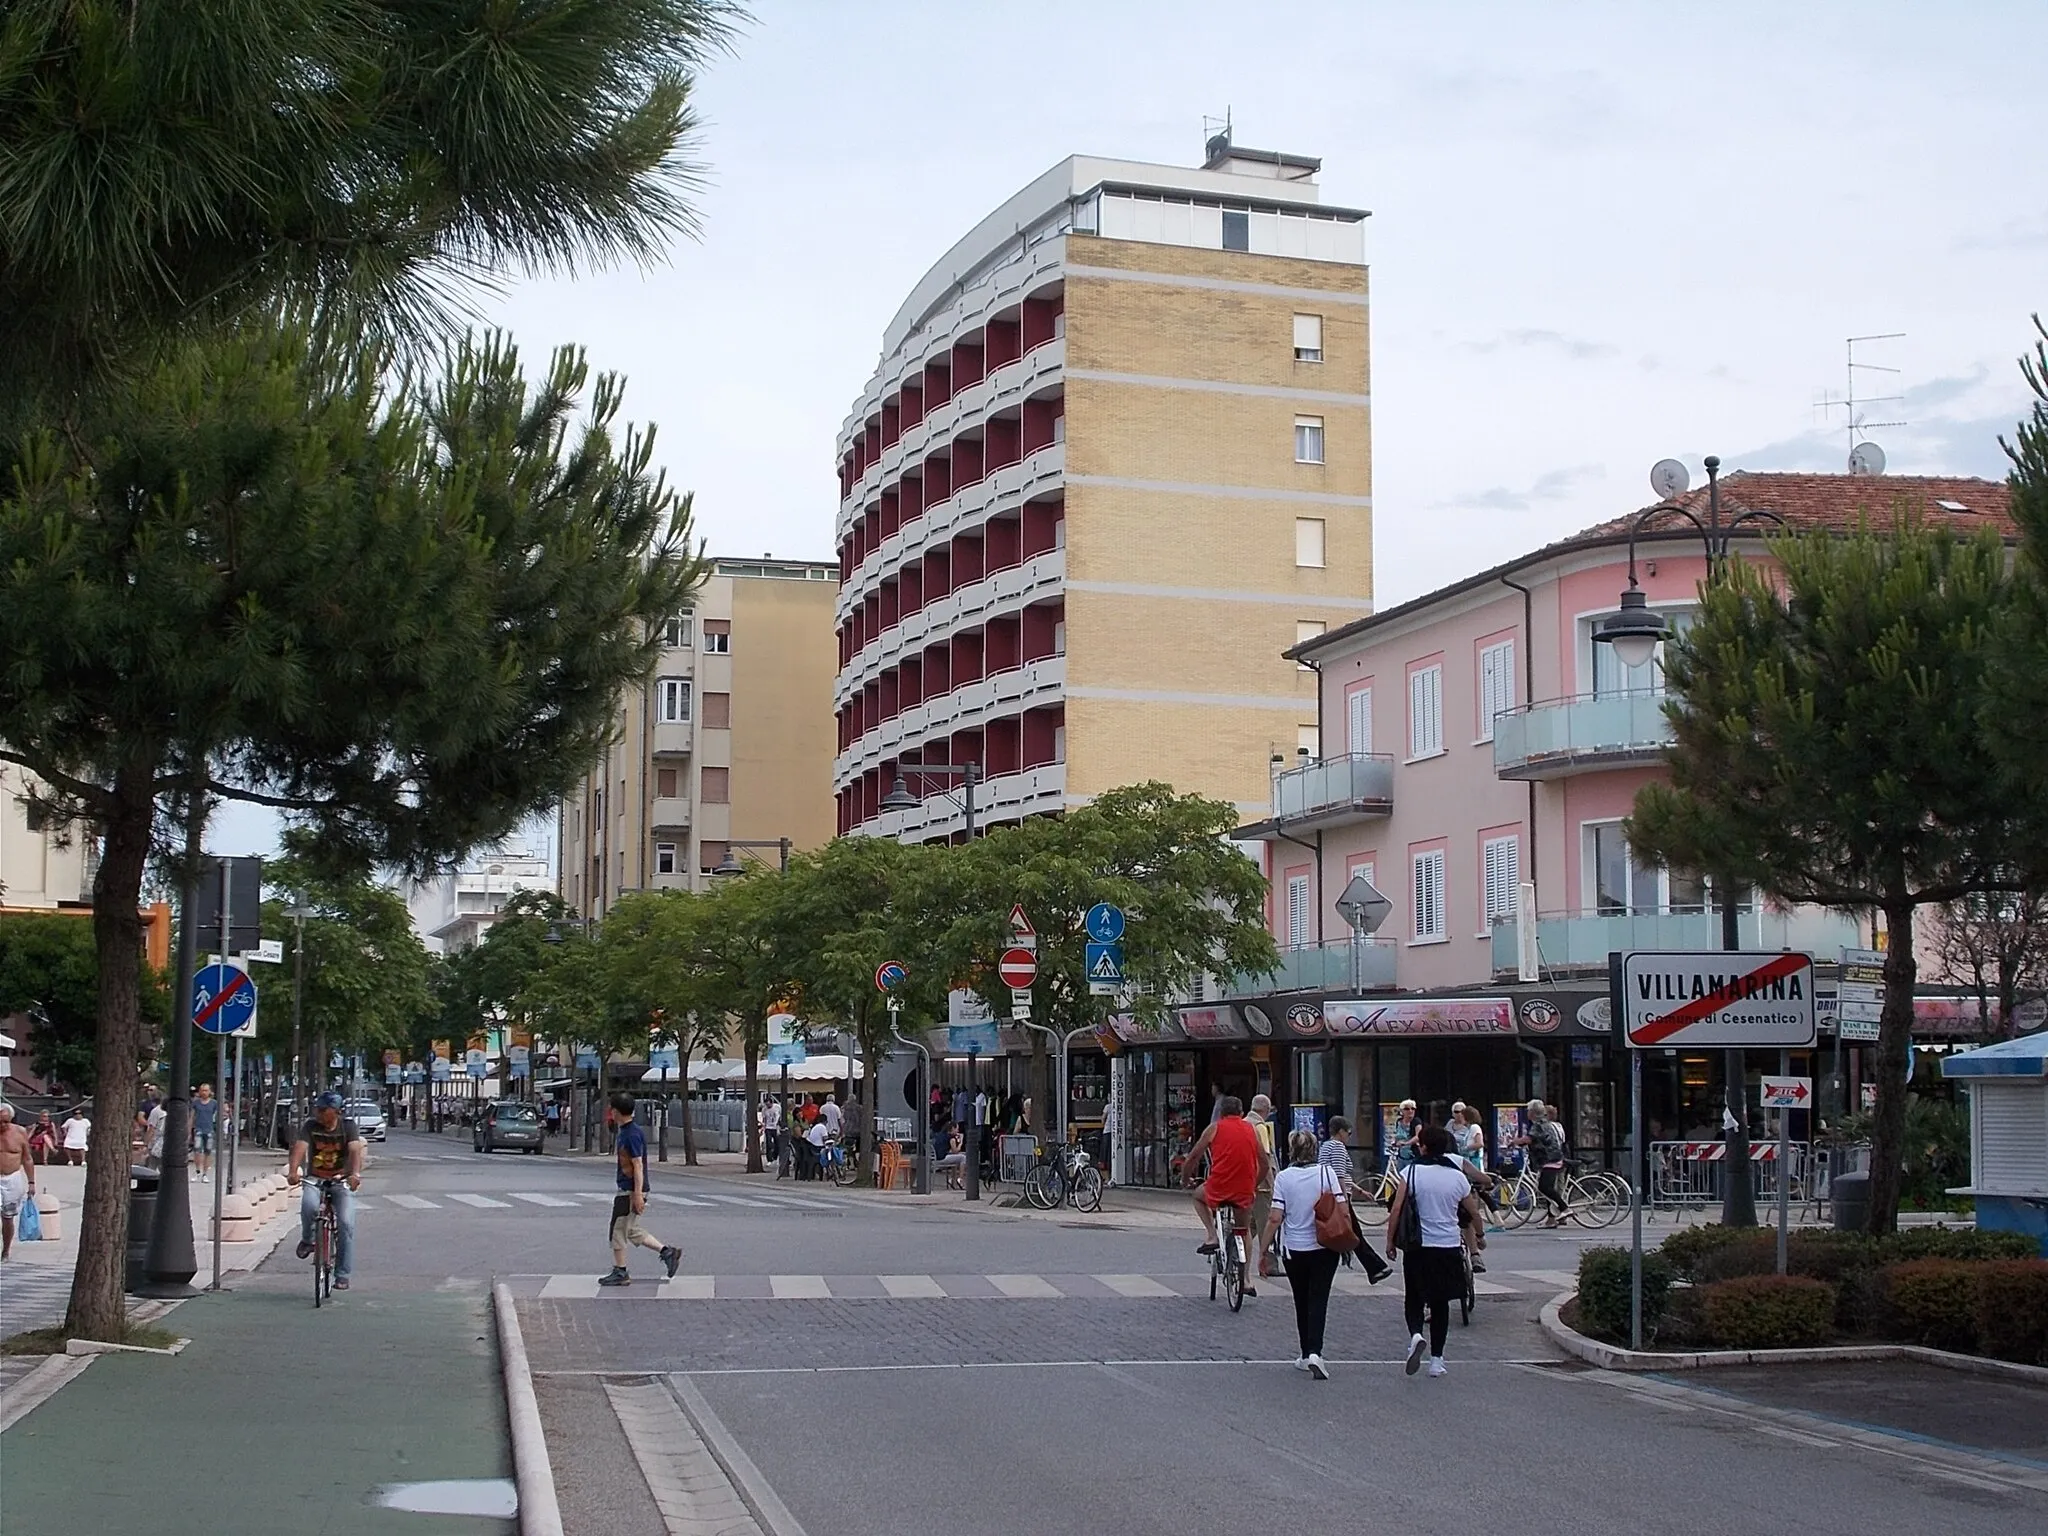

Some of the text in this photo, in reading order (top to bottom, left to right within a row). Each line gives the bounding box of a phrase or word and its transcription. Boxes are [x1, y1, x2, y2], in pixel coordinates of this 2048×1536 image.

[1638, 974, 1803, 1001] VILLAMARINA
[1345, 1007, 1504, 1033] ALEXANDER
[1705, 1012, 1717, 1024] di
[1726, 1012, 1804, 1025] Cesenatico)
